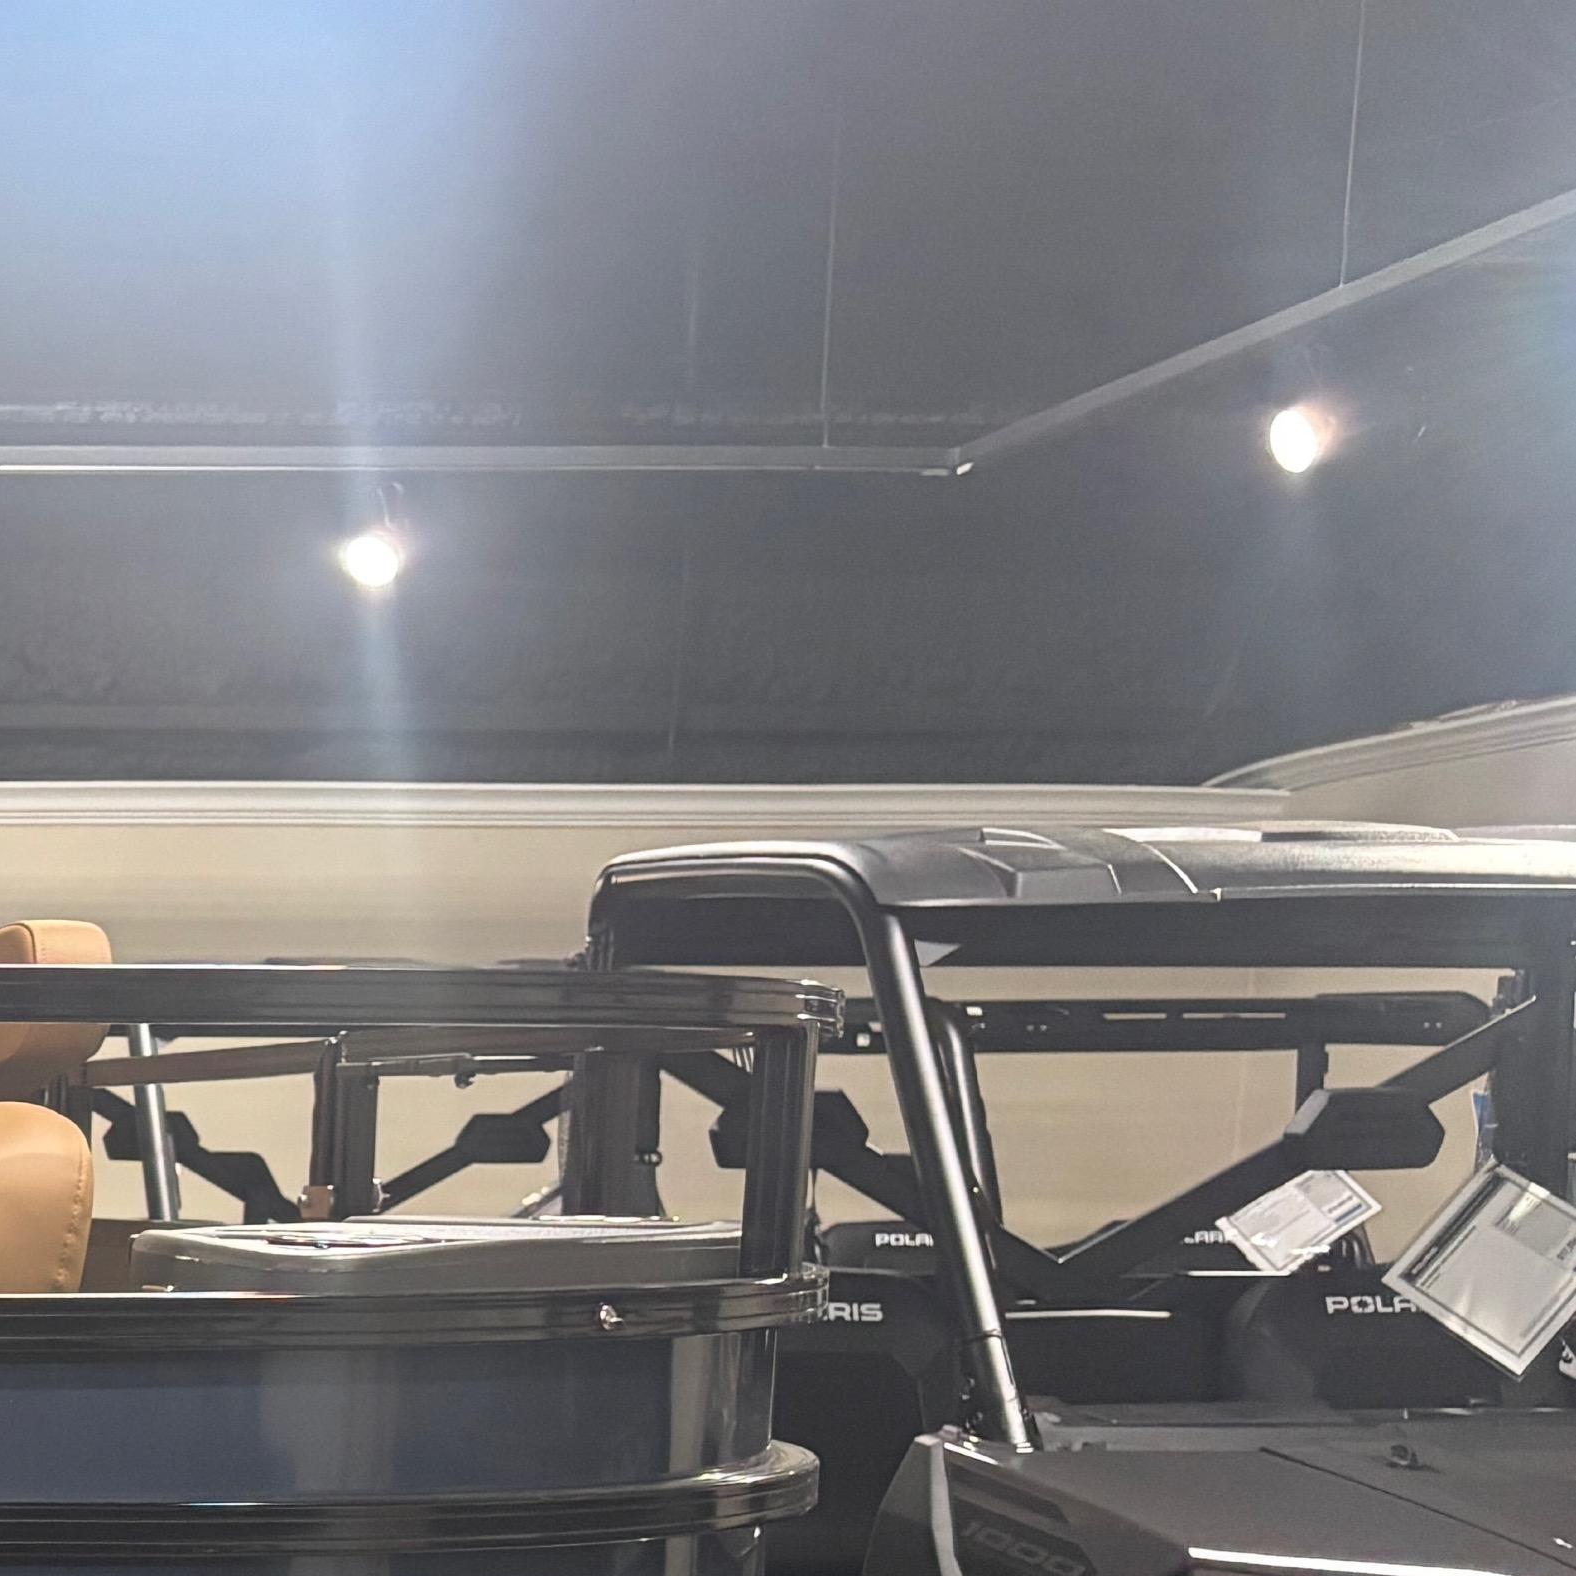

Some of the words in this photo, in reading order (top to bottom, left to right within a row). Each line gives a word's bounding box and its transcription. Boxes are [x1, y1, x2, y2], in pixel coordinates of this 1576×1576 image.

[874, 1232, 935, 1248] POLA
[823, 1301, 884, 1322] RIS
[1325, 1295, 1417, 1315] POLA
